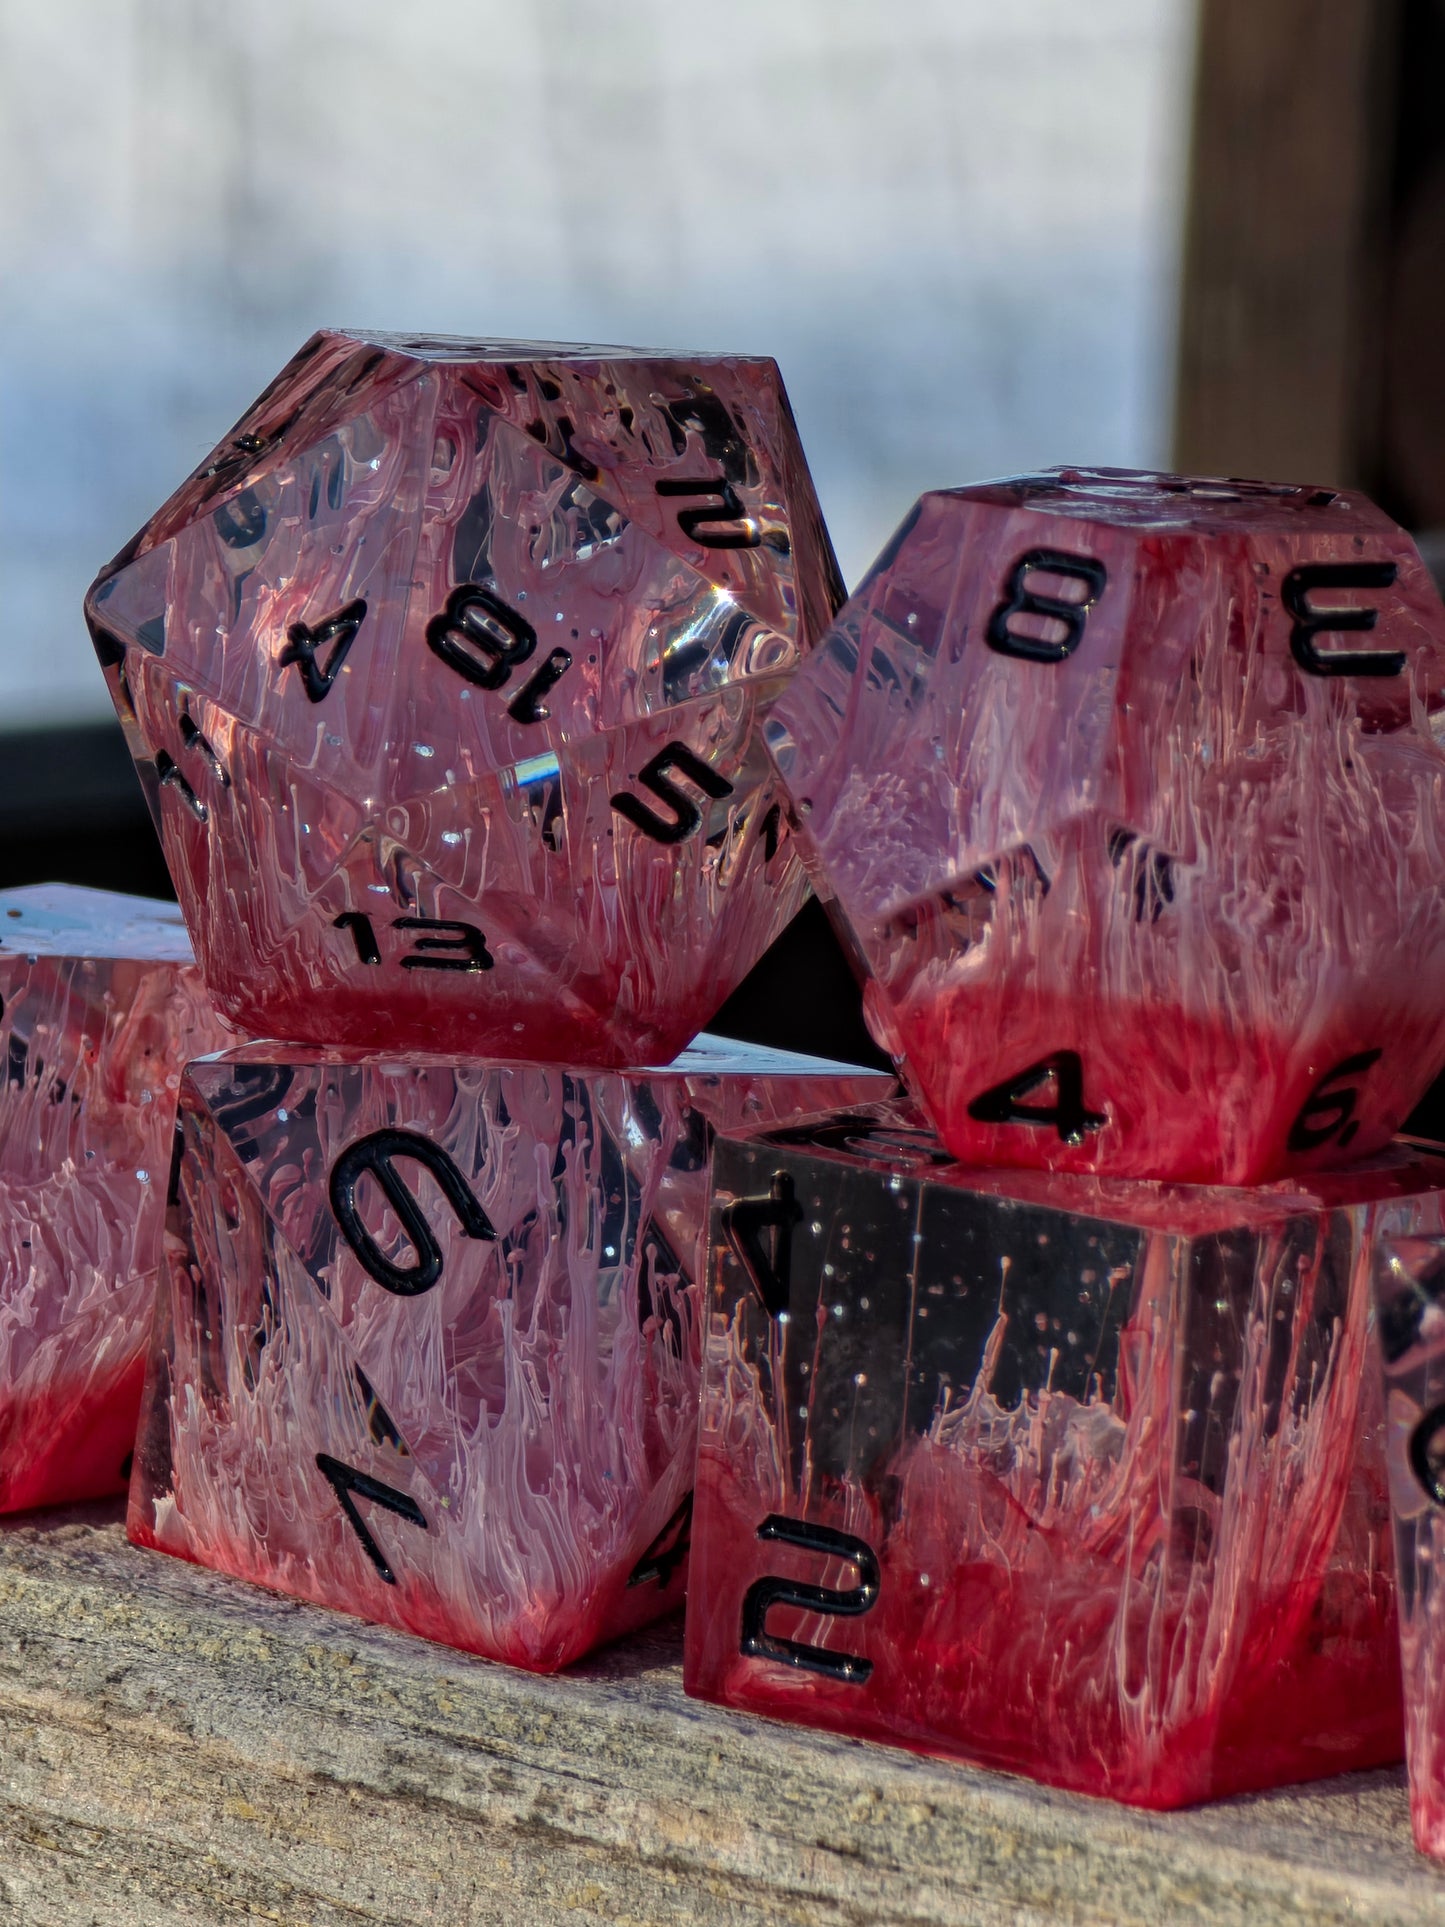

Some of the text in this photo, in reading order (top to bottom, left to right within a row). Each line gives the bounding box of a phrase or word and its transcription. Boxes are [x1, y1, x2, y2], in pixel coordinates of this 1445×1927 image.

[655, 477, 761, 549] 2
[278, 597, 368, 704] 4
[985, 547, 1106, 663] 8
[610, 740, 734, 845] 5
[333, 911, 494, 973] 13
[967, 1050, 1107, 1147] 4
[740, 1512, 880, 1686] 2
